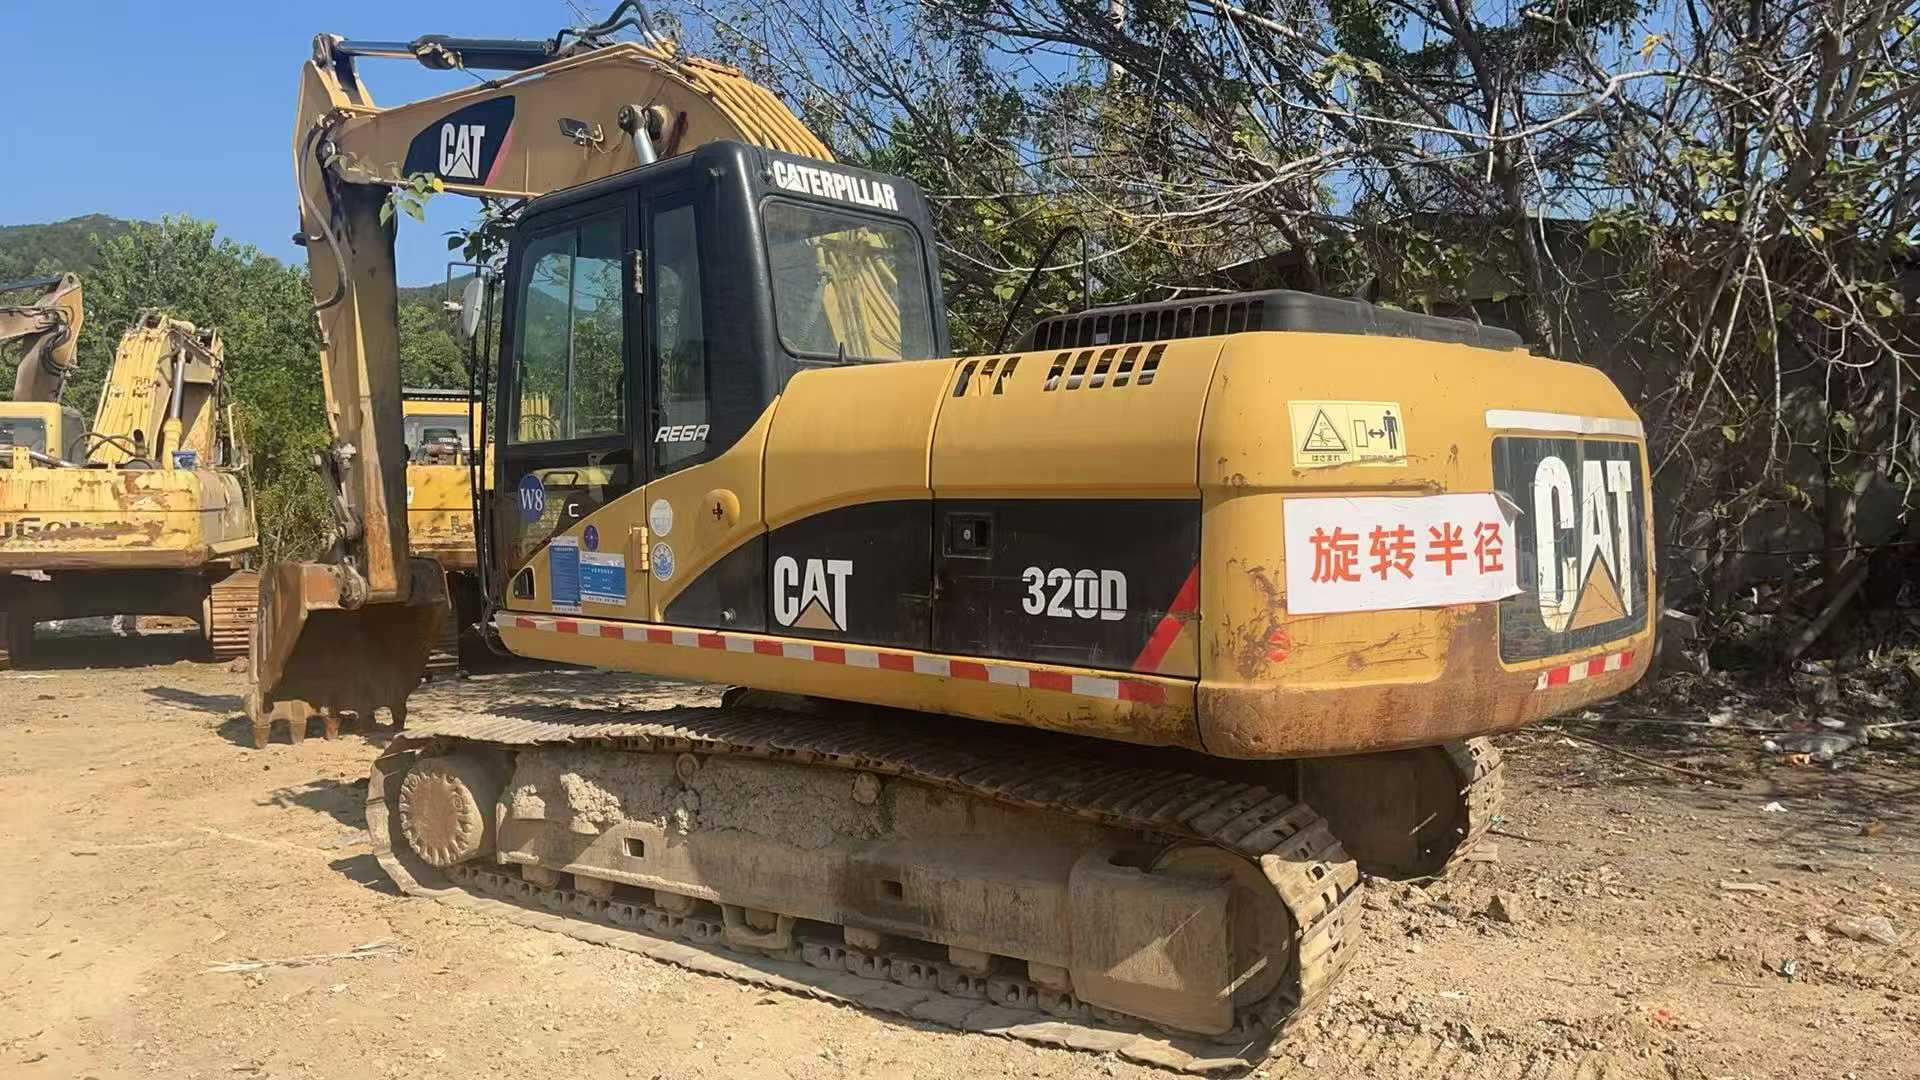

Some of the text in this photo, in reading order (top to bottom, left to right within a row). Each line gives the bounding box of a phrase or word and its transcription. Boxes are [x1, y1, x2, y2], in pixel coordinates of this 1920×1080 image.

[439, 122, 485, 179] CAT
[772, 160, 899, 212] CATERPILLAR
[654, 424, 710, 443] REGA
[519, 487, 544, 512] W8
[1309, 520, 1505, 584] 旋转半径
[1534, 455, 1633, 633] CAT
[773, 555, 853, 632] CAT
[1022, 566, 1128, 621] 320D
